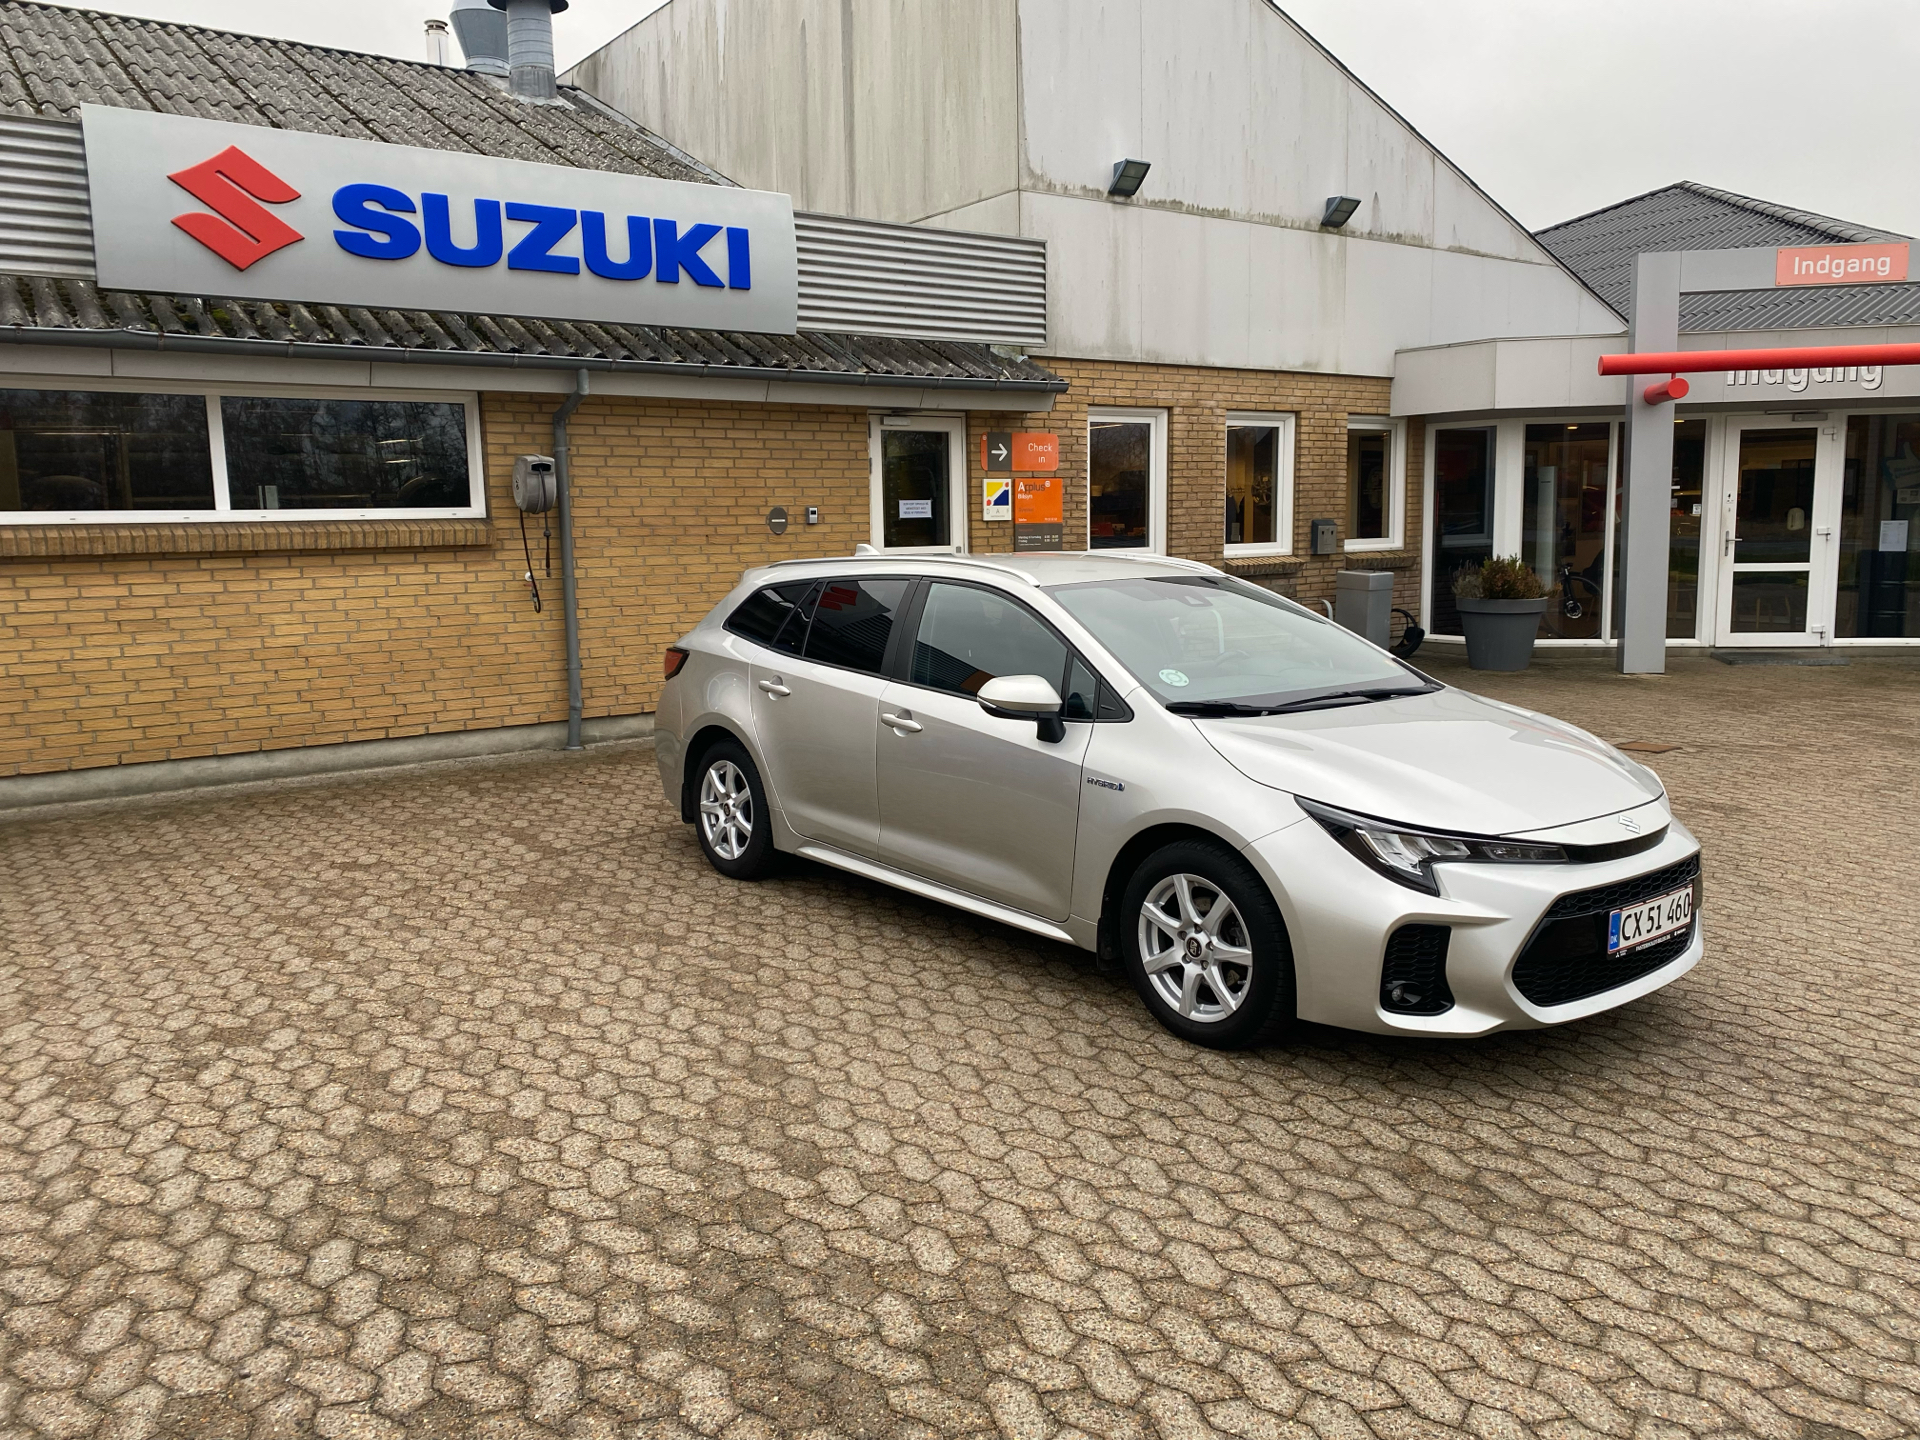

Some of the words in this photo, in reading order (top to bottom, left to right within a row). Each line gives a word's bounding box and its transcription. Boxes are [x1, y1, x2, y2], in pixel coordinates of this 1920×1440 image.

[332, 182, 751, 290] SUZUKI
[1794, 254, 1891, 278] Indgang
[1028, 442, 1053, 452] Check
[1018, 481, 1046, 494] Applus
[1621, 910, 1644, 941] CX
[1647, 904, 1662, 934] 51
[1667, 892, 1691, 924] 460
[1610, 934, 1618, 945] DK
